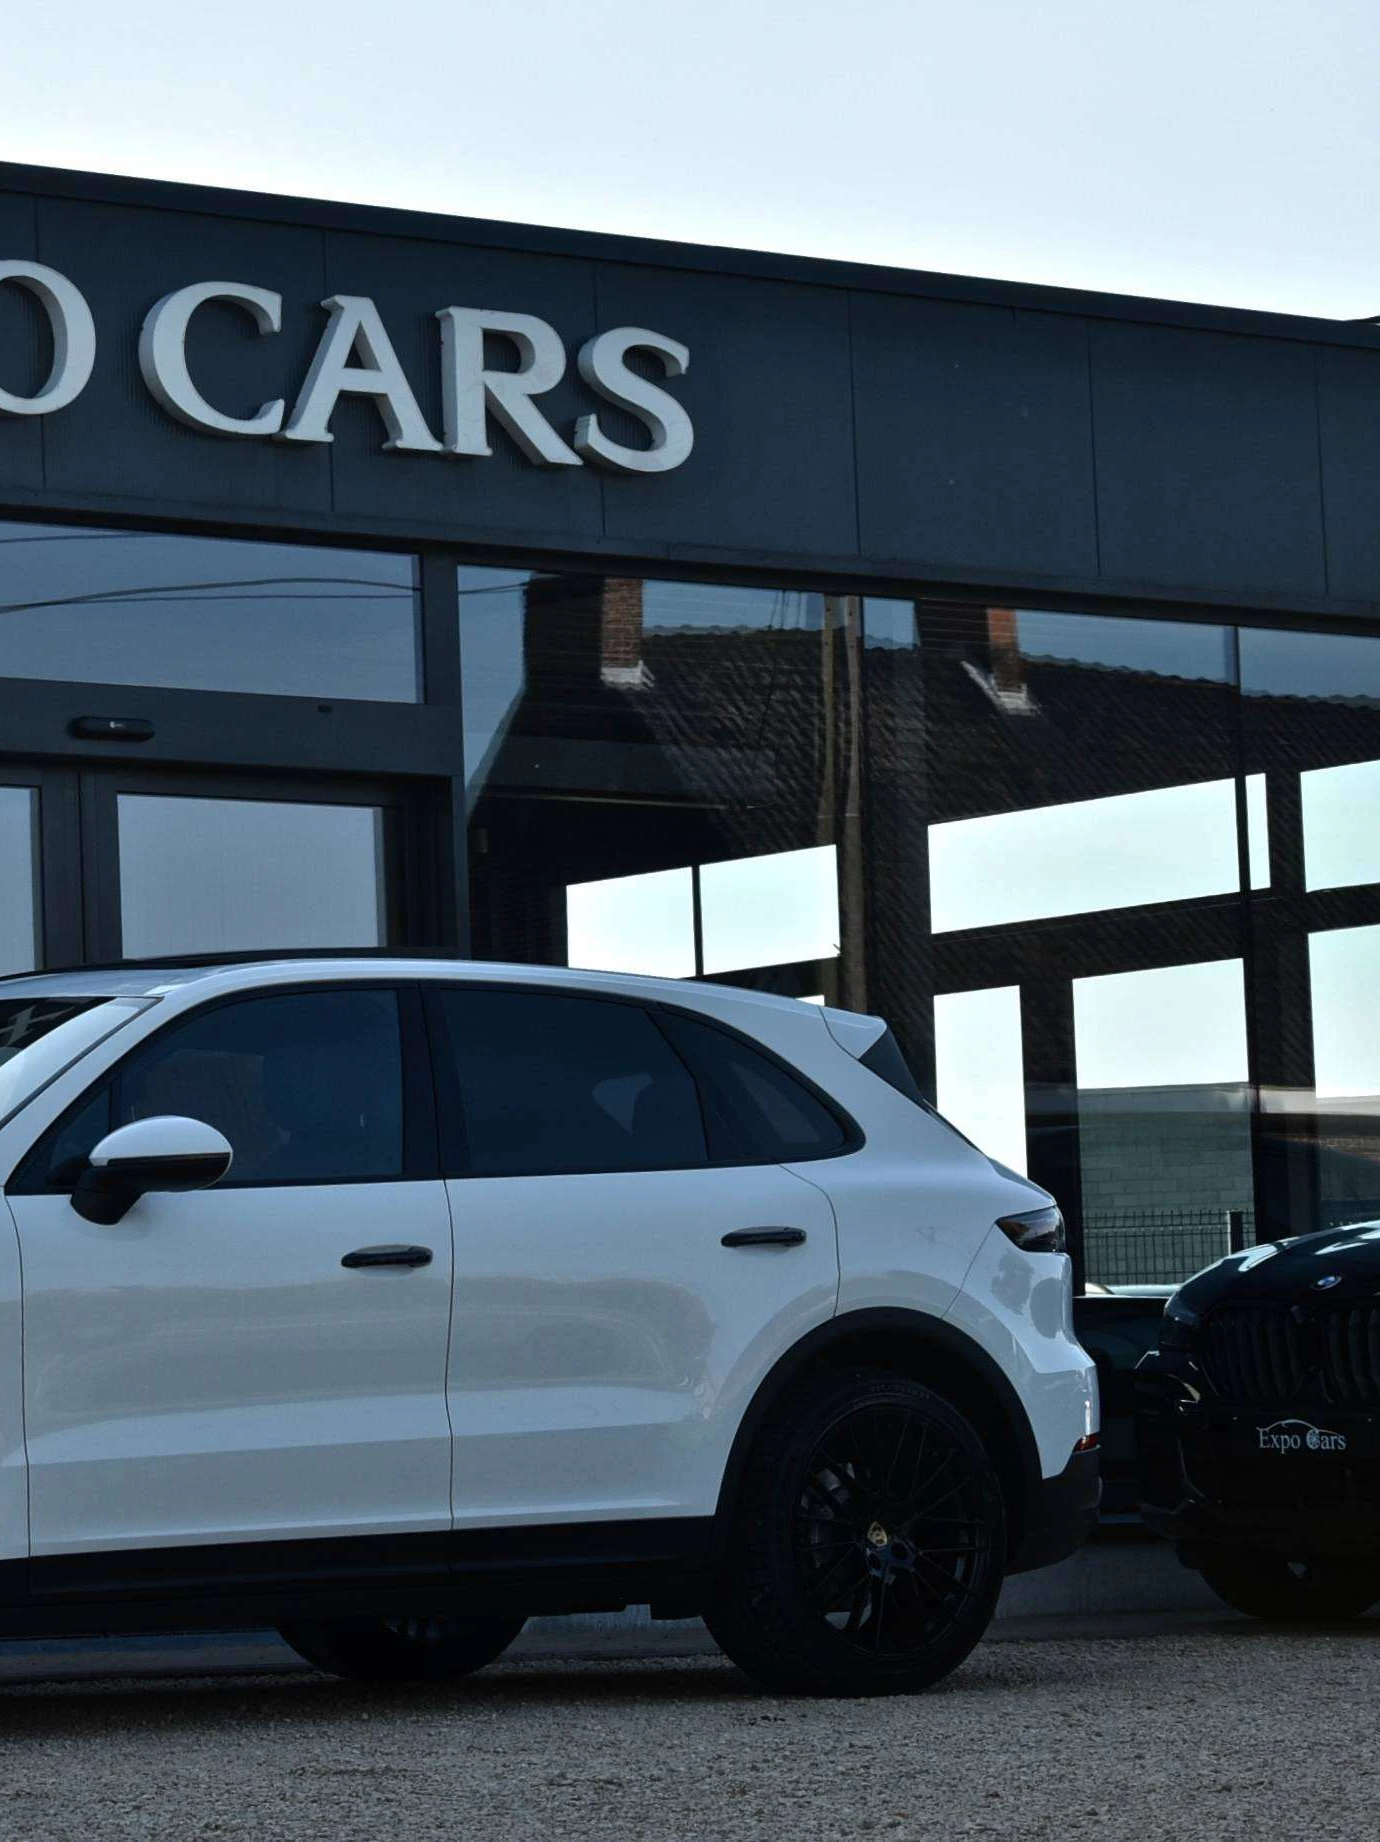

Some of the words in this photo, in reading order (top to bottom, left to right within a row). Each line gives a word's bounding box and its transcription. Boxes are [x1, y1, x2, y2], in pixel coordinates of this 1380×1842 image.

[138, 280, 694, 472] CARS
[1259, 1428, 1301, 1454] Expo
[1306, 1428, 1346, 1450] Cars
